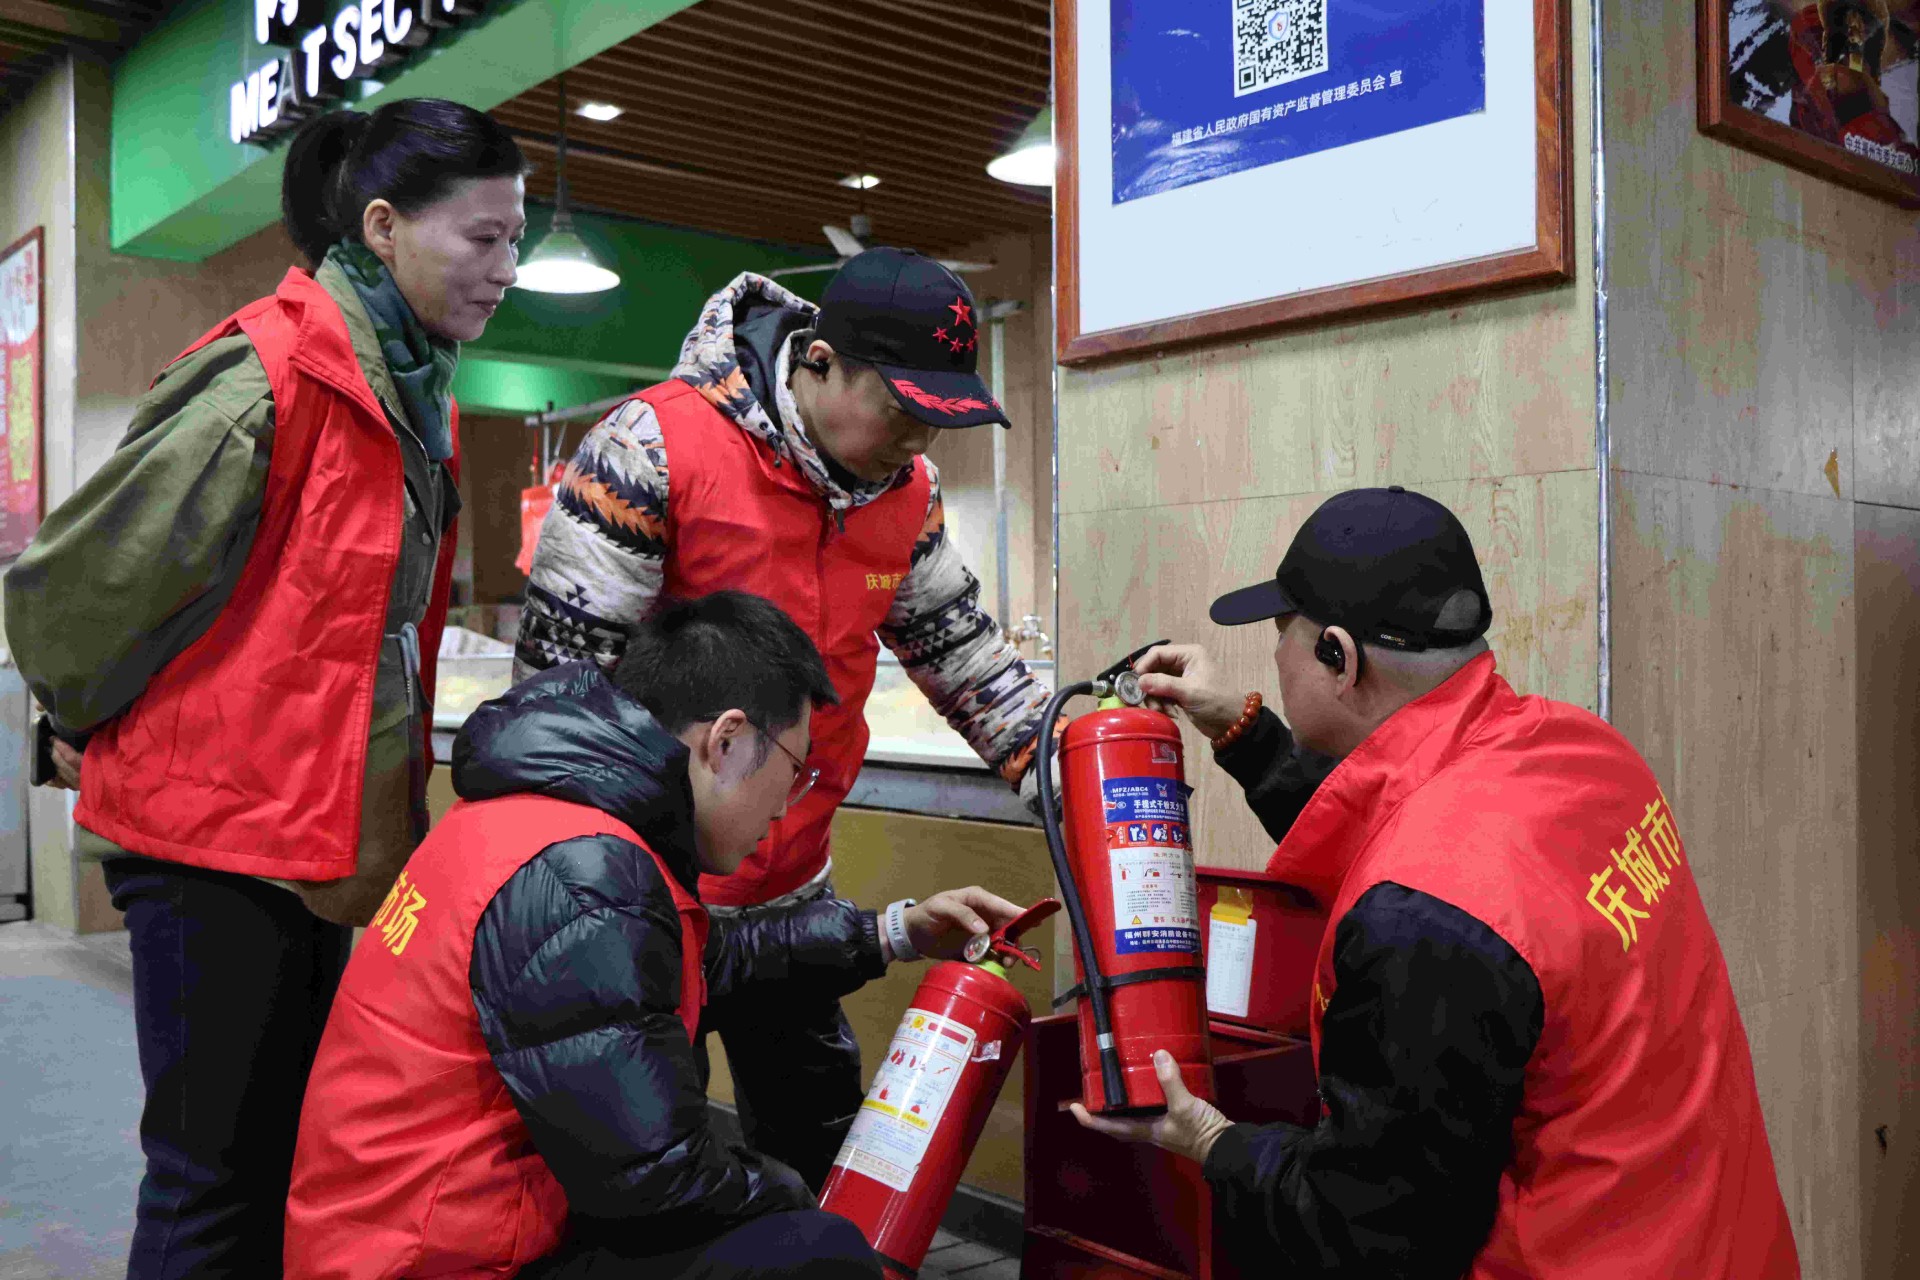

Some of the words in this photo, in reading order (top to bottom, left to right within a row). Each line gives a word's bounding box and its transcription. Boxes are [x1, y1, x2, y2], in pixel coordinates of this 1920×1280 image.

[230, 25, 326, 144] MEAT
[331, 0, 454, 80] SEC
[1172, 75, 1385, 147] 福建省人民政府国有资产监督管理委员会
[1389, 70, 1402, 87] 宣
[1845, 132, 1919, 175] 中共福州市委文明办
[865, 573, 905, 590] 庆城市
[1586, 798, 1681, 953] 庆城市
